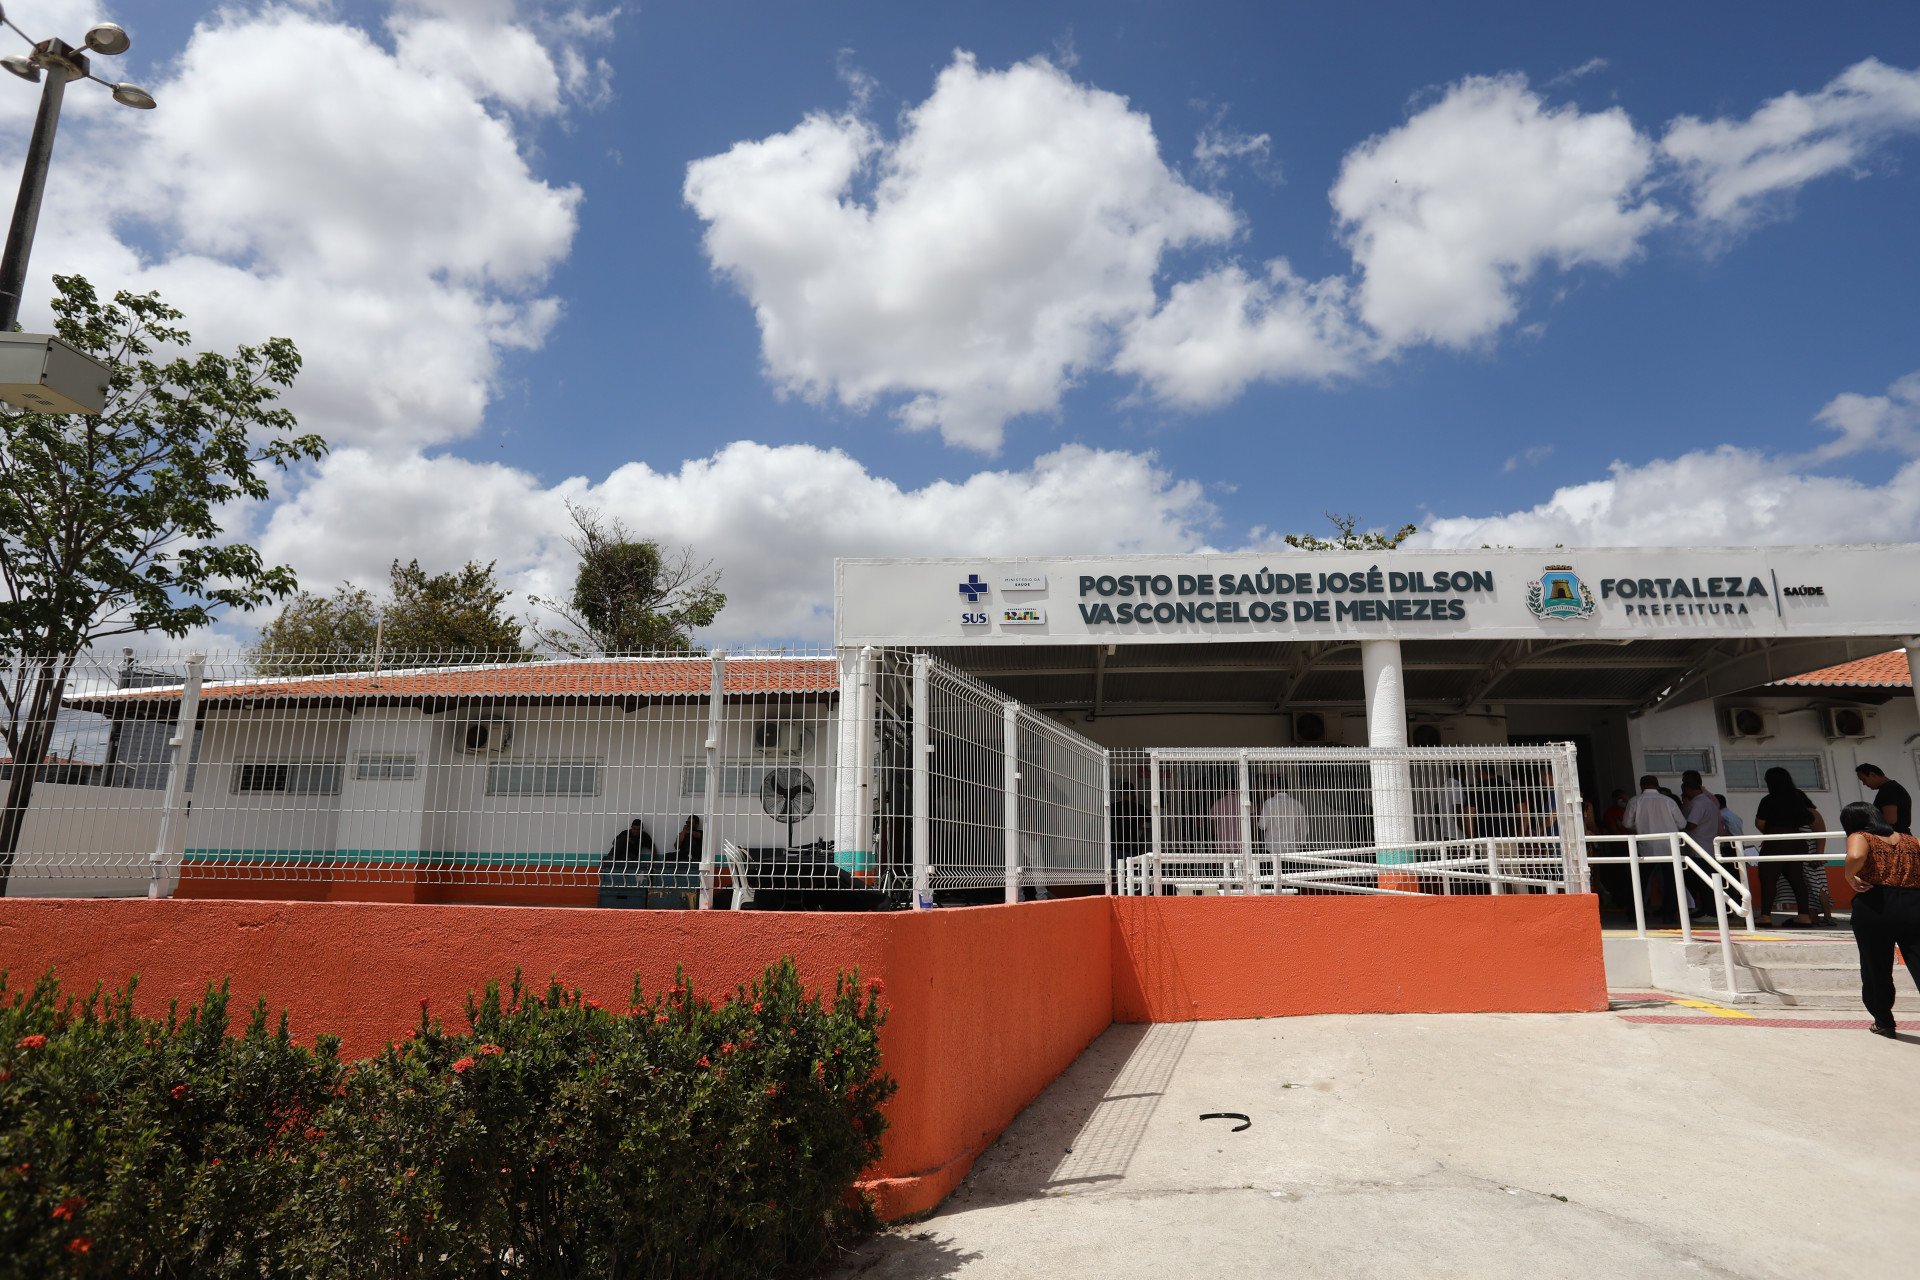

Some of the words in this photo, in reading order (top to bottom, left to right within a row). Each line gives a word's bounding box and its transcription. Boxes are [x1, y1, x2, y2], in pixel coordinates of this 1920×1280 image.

[1079, 574, 1173, 597] POSTO
[1177, 573, 1214, 596] DE
[1218, 566, 1313, 595] SAÚDE
[1317, 564, 1385, 594] JOSÉ
[1388, 570, 1494, 593] DILSON
[1600, 577, 1769, 599] FORTALEZA
[1783, 585, 1825, 597] SAÚDE
[1004, 610, 1040, 621] BRASIL
[1078, 601, 1289, 625] VASCONCELOS
[1293, 600, 1331, 622] DE
[1335, 599, 1466, 622] MENEZES
[1625, 603, 1749, 616] PREFEITURA
[961, 612, 987, 624] SUS
